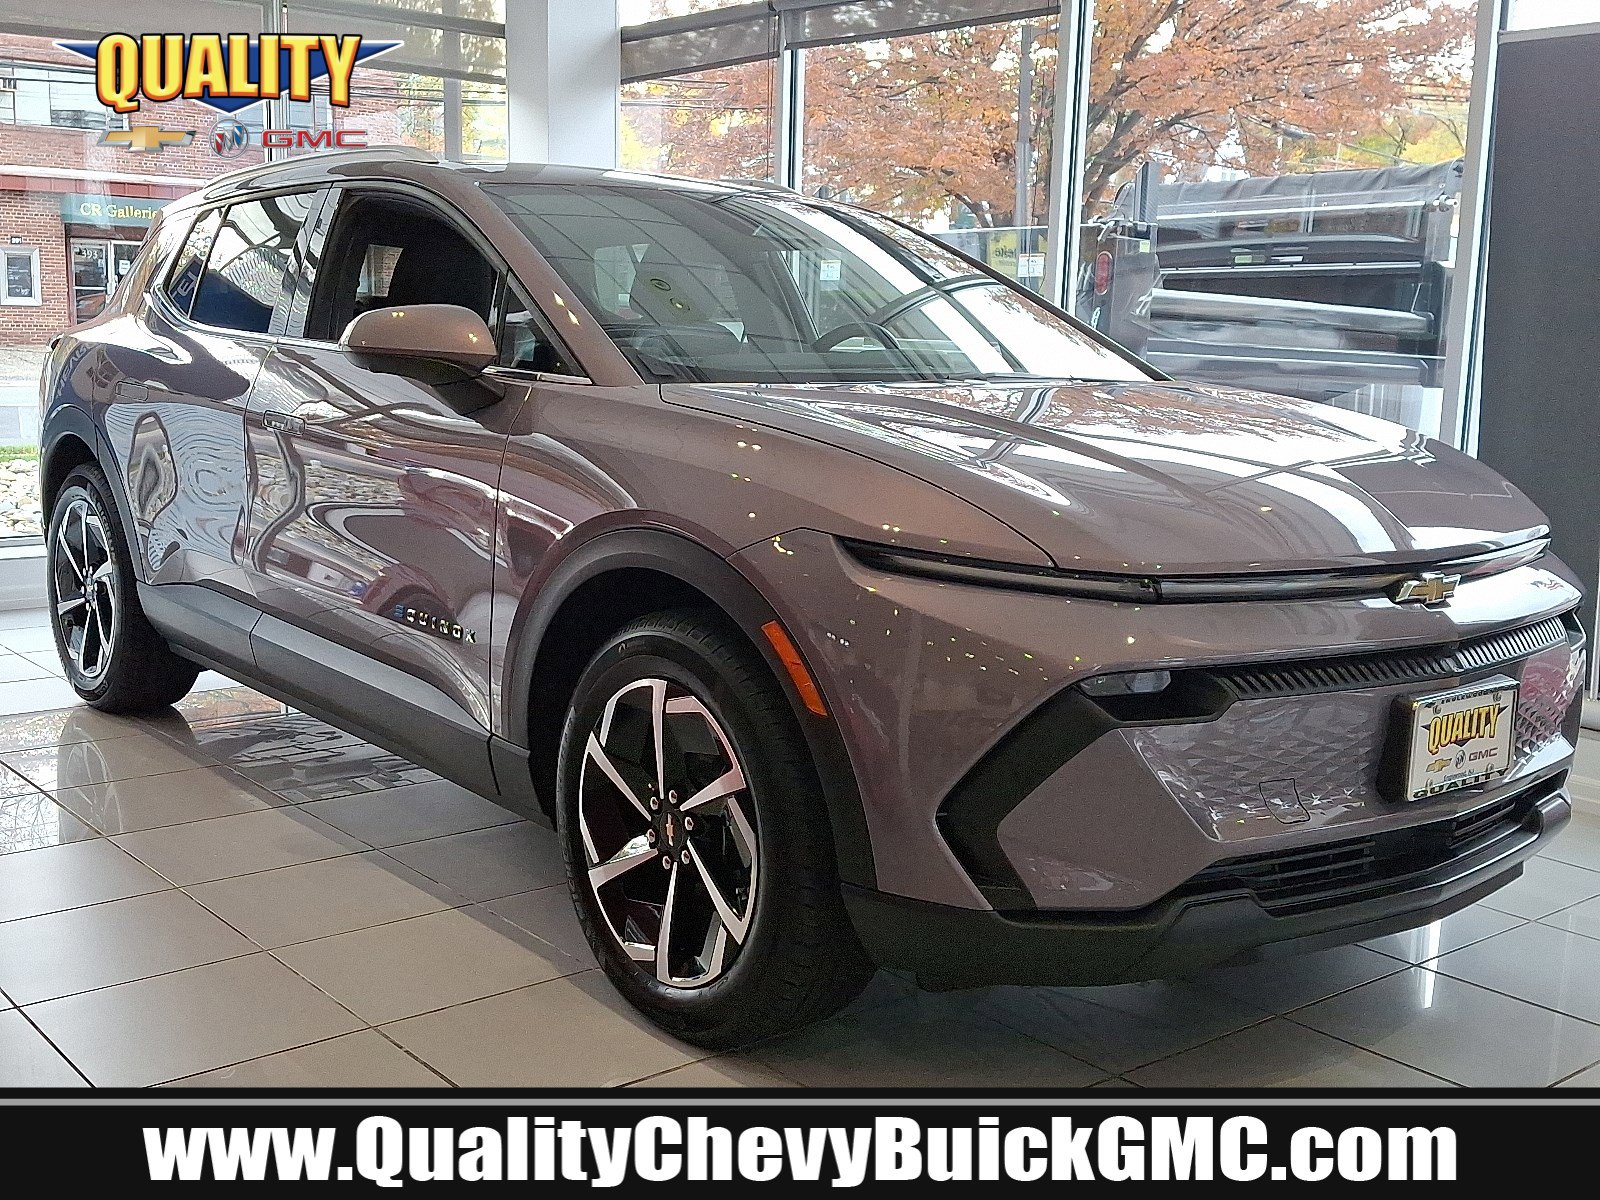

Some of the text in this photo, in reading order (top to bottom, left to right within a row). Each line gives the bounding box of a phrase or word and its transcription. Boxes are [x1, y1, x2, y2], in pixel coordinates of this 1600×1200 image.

[80, 203, 103, 217] CR
[82, 249, 98, 259] 393
[394, 604, 476, 643] EQUINOX
[1428, 703, 1501, 755] QUALITY
[1468, 747, 1498, 761] GMC
[1413, 767, 1509, 799] QUALITY
